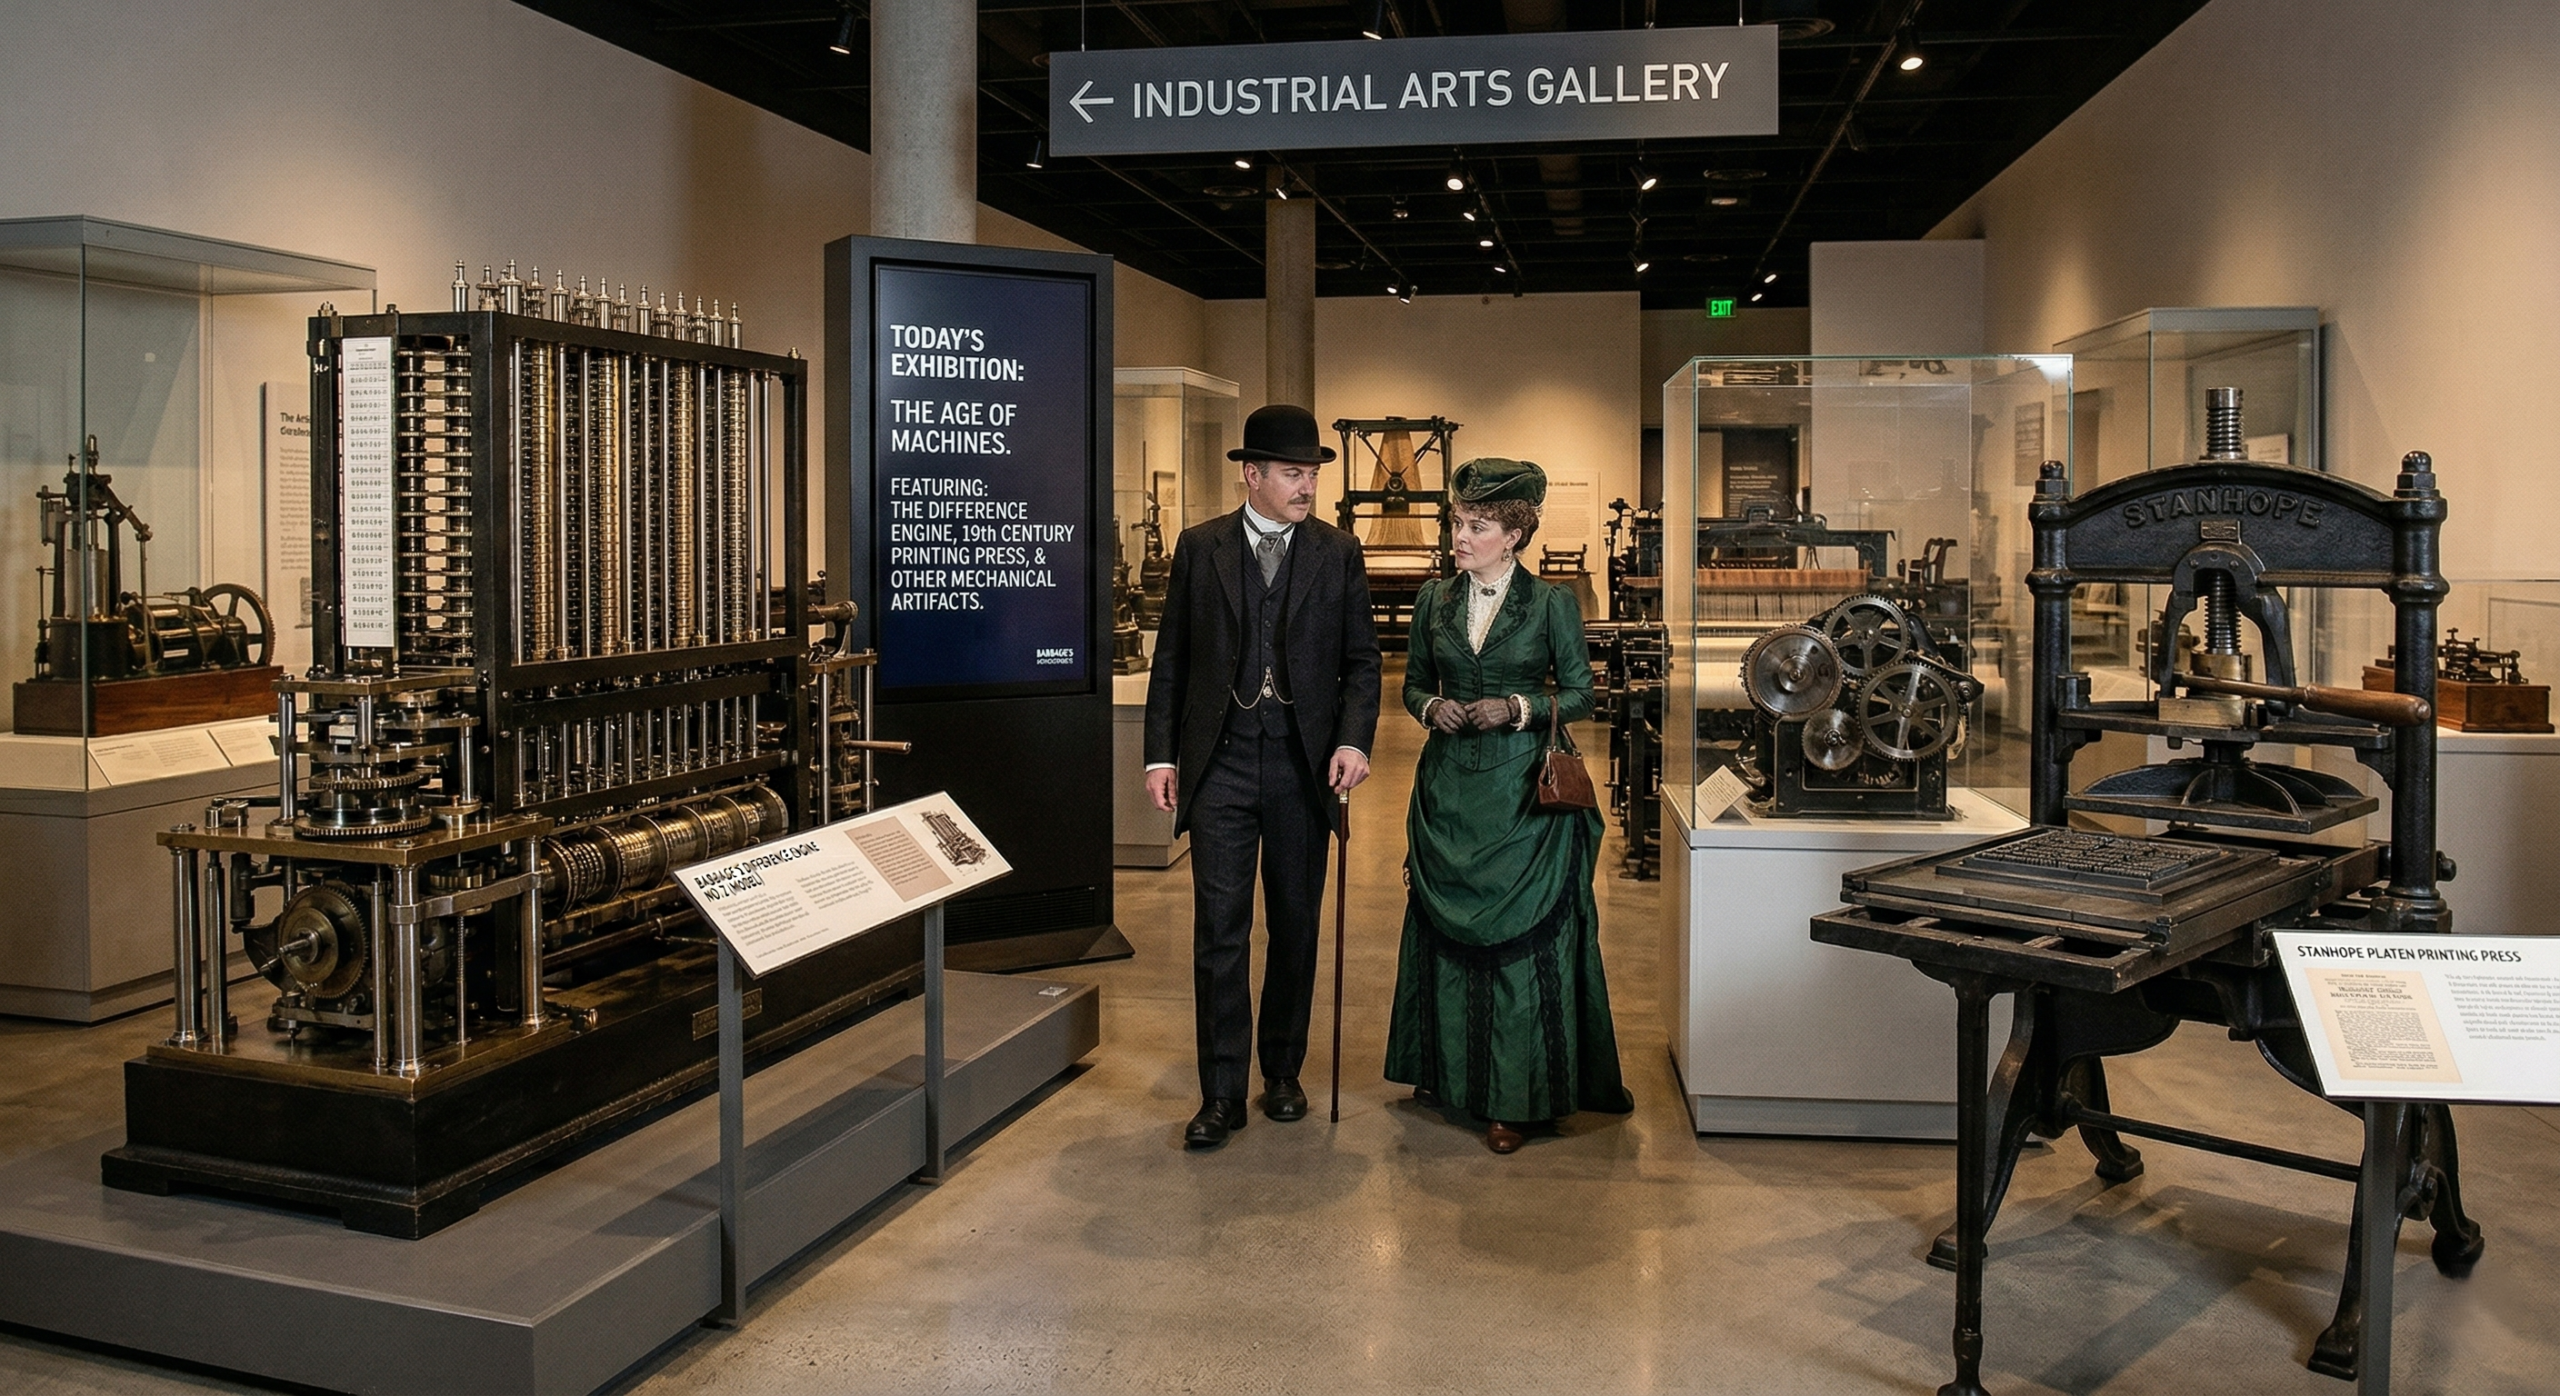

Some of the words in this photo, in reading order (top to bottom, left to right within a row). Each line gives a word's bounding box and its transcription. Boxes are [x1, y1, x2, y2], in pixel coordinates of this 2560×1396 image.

[1134, 74, 1388, 119] INDUSTRIAL
[1398, 69, 1513, 109] ARTS
[1527, 61, 1730, 105] GALLERY
[1711, 300, 1733, 316] EXIT
[890, 324, 985, 352] TODAY'S
[891, 353, 1025, 382] EXHIBITION:
[890, 399, 935, 424] THE
[939, 401, 984, 426] AGE
[988, 403, 1018, 427] OF
[891, 429, 1011, 455] MACHINES.
[891, 477, 989, 497] FEATURING:
[890, 501, 924, 519] THE
[928, 501, 1028, 520] DIFFERENCE
[2123, 487, 2326, 528] STANHOPE
[891, 523, 958, 546] ENGINE,
[962, 524, 997, 542] 19th
[1001, 524, 1075, 543] CENTURY
[891, 547, 970, 565] PRINTING
[975, 547, 1030, 569] PRESS,
[1034, 547, 1047, 565] &
[891, 570, 947, 589] OTHER
[951, 570, 1057, 588] MECHANICAL
[890, 592, 985, 611] ARTIFACTS.
[2297, 945, 2365, 959] STANHOPE
[2367, 947, 2415, 960] PLATEN
[2418, 949, 2479, 962] PRINTING
[2481, 951, 2522, 963] PRESS
